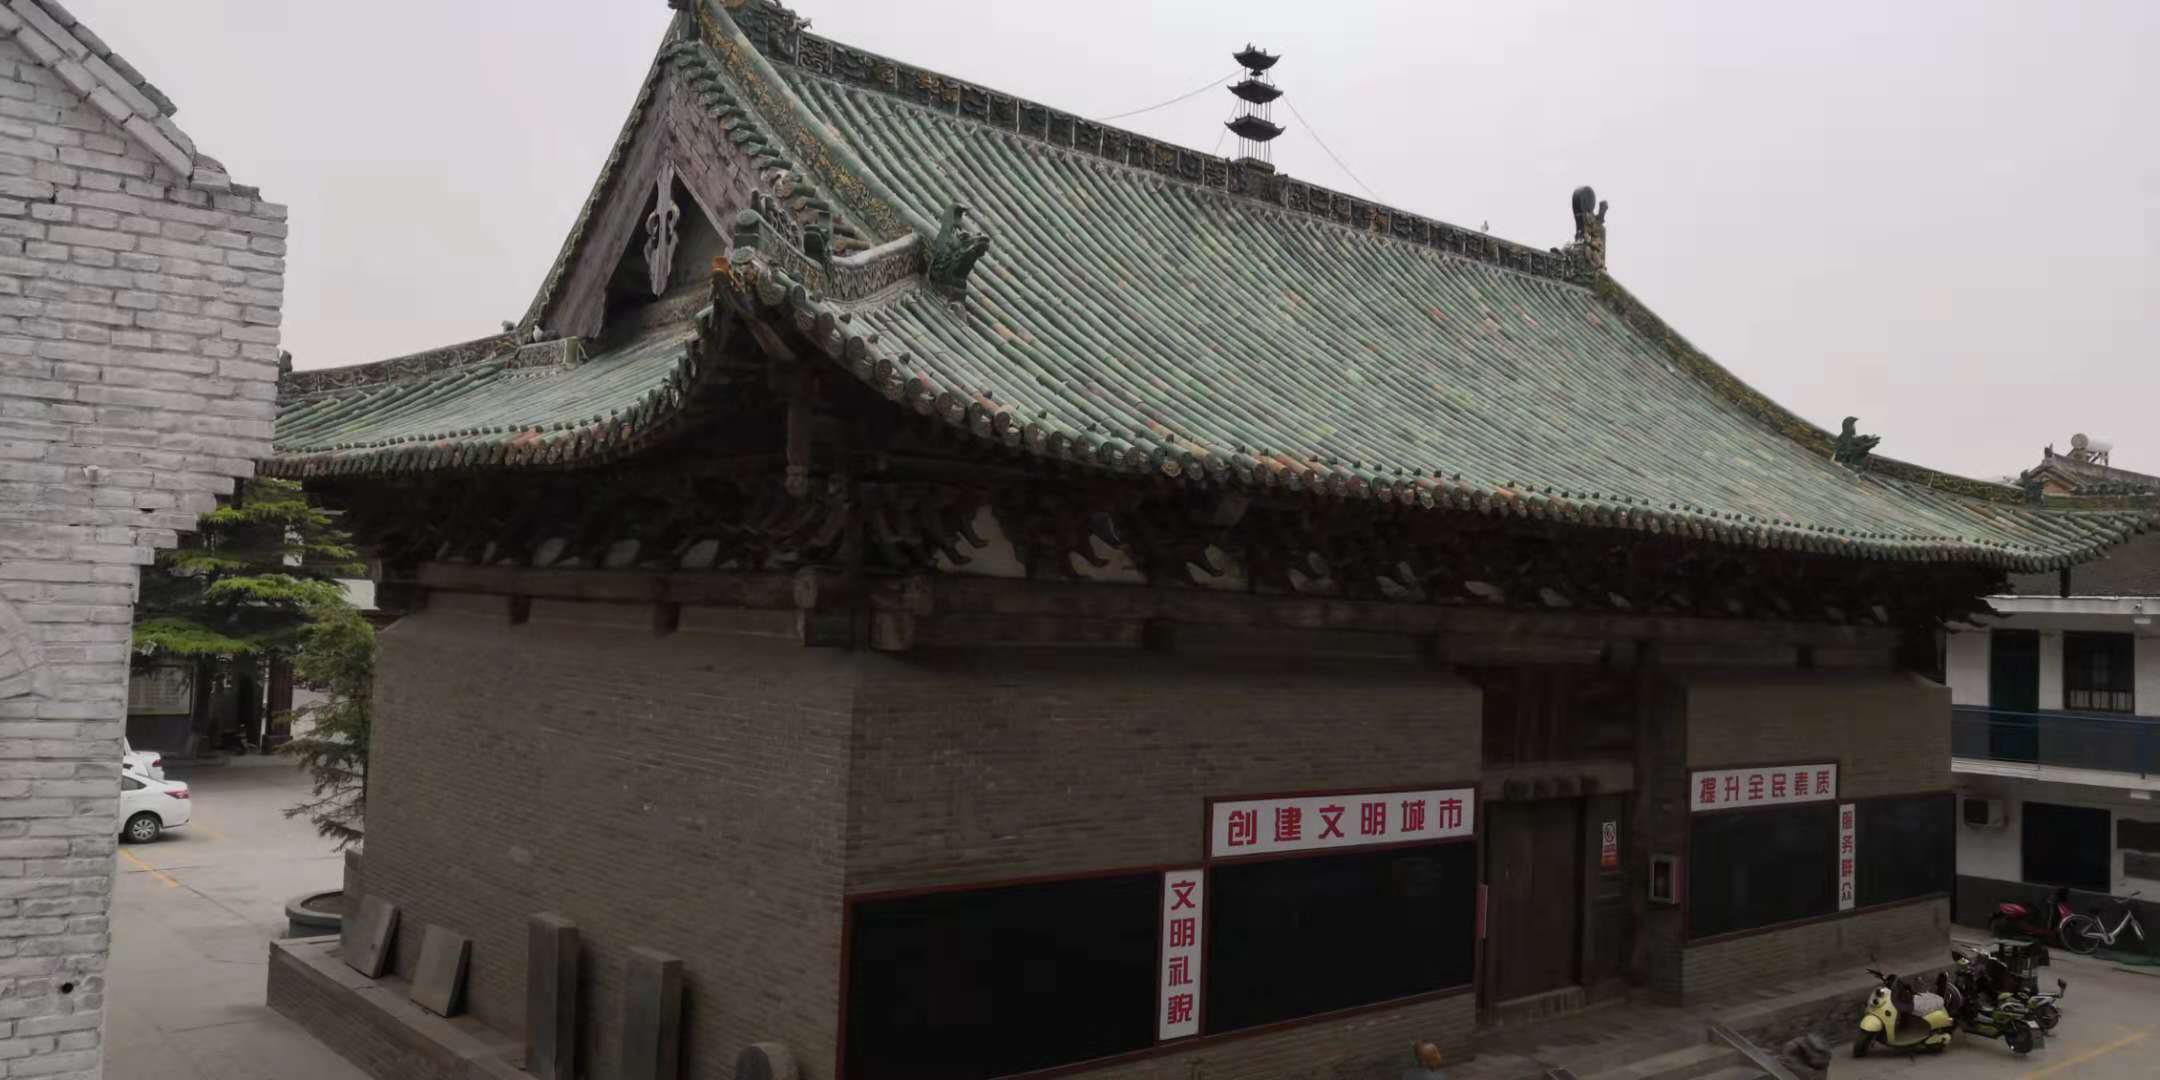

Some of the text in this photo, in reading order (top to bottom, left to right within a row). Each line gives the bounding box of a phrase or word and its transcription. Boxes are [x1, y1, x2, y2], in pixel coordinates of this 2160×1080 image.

[1699, 770, 1830, 804] 提升全民素质
[1227, 798, 1463, 846] 创建文明城市
[1840, 811, 1854, 901] 服务群众
[1167, 880, 1196, 1024] 文明礼貌
